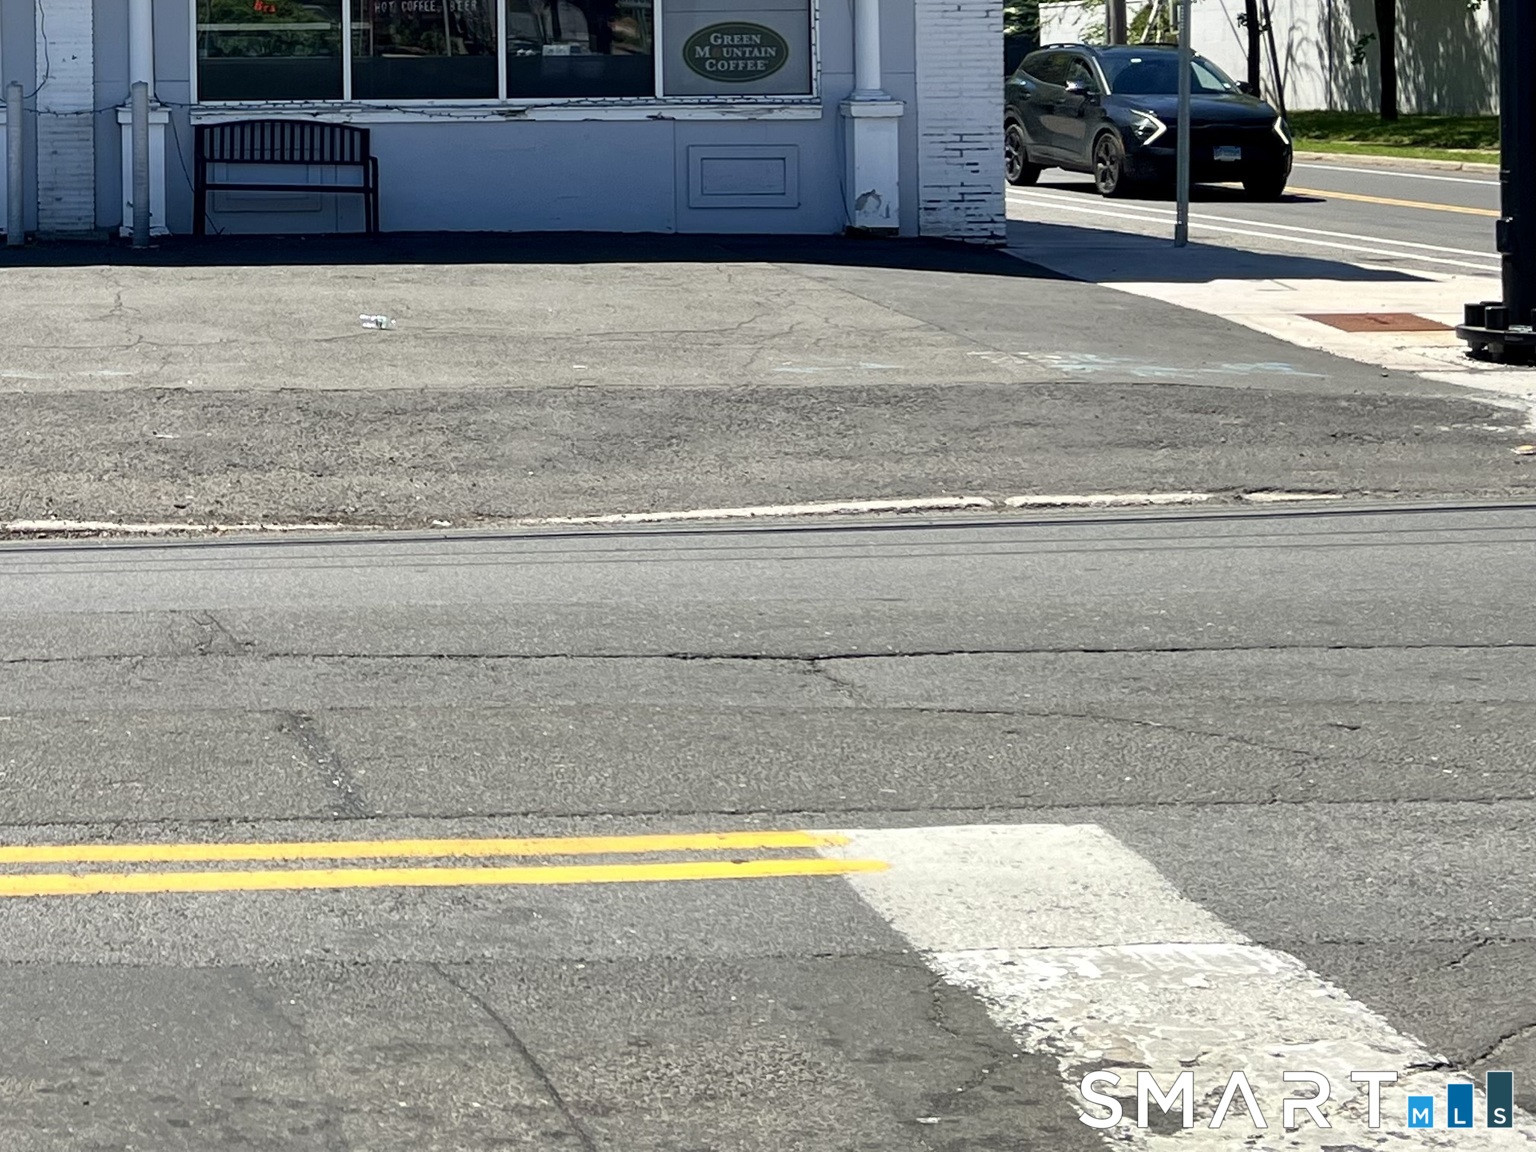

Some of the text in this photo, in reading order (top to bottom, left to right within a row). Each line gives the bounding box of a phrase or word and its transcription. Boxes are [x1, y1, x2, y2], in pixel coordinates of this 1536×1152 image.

[449, 0, 478, 12] BEER
[709, 33, 762, 45] GREEN
[705, 59, 766, 71] COFFEE
